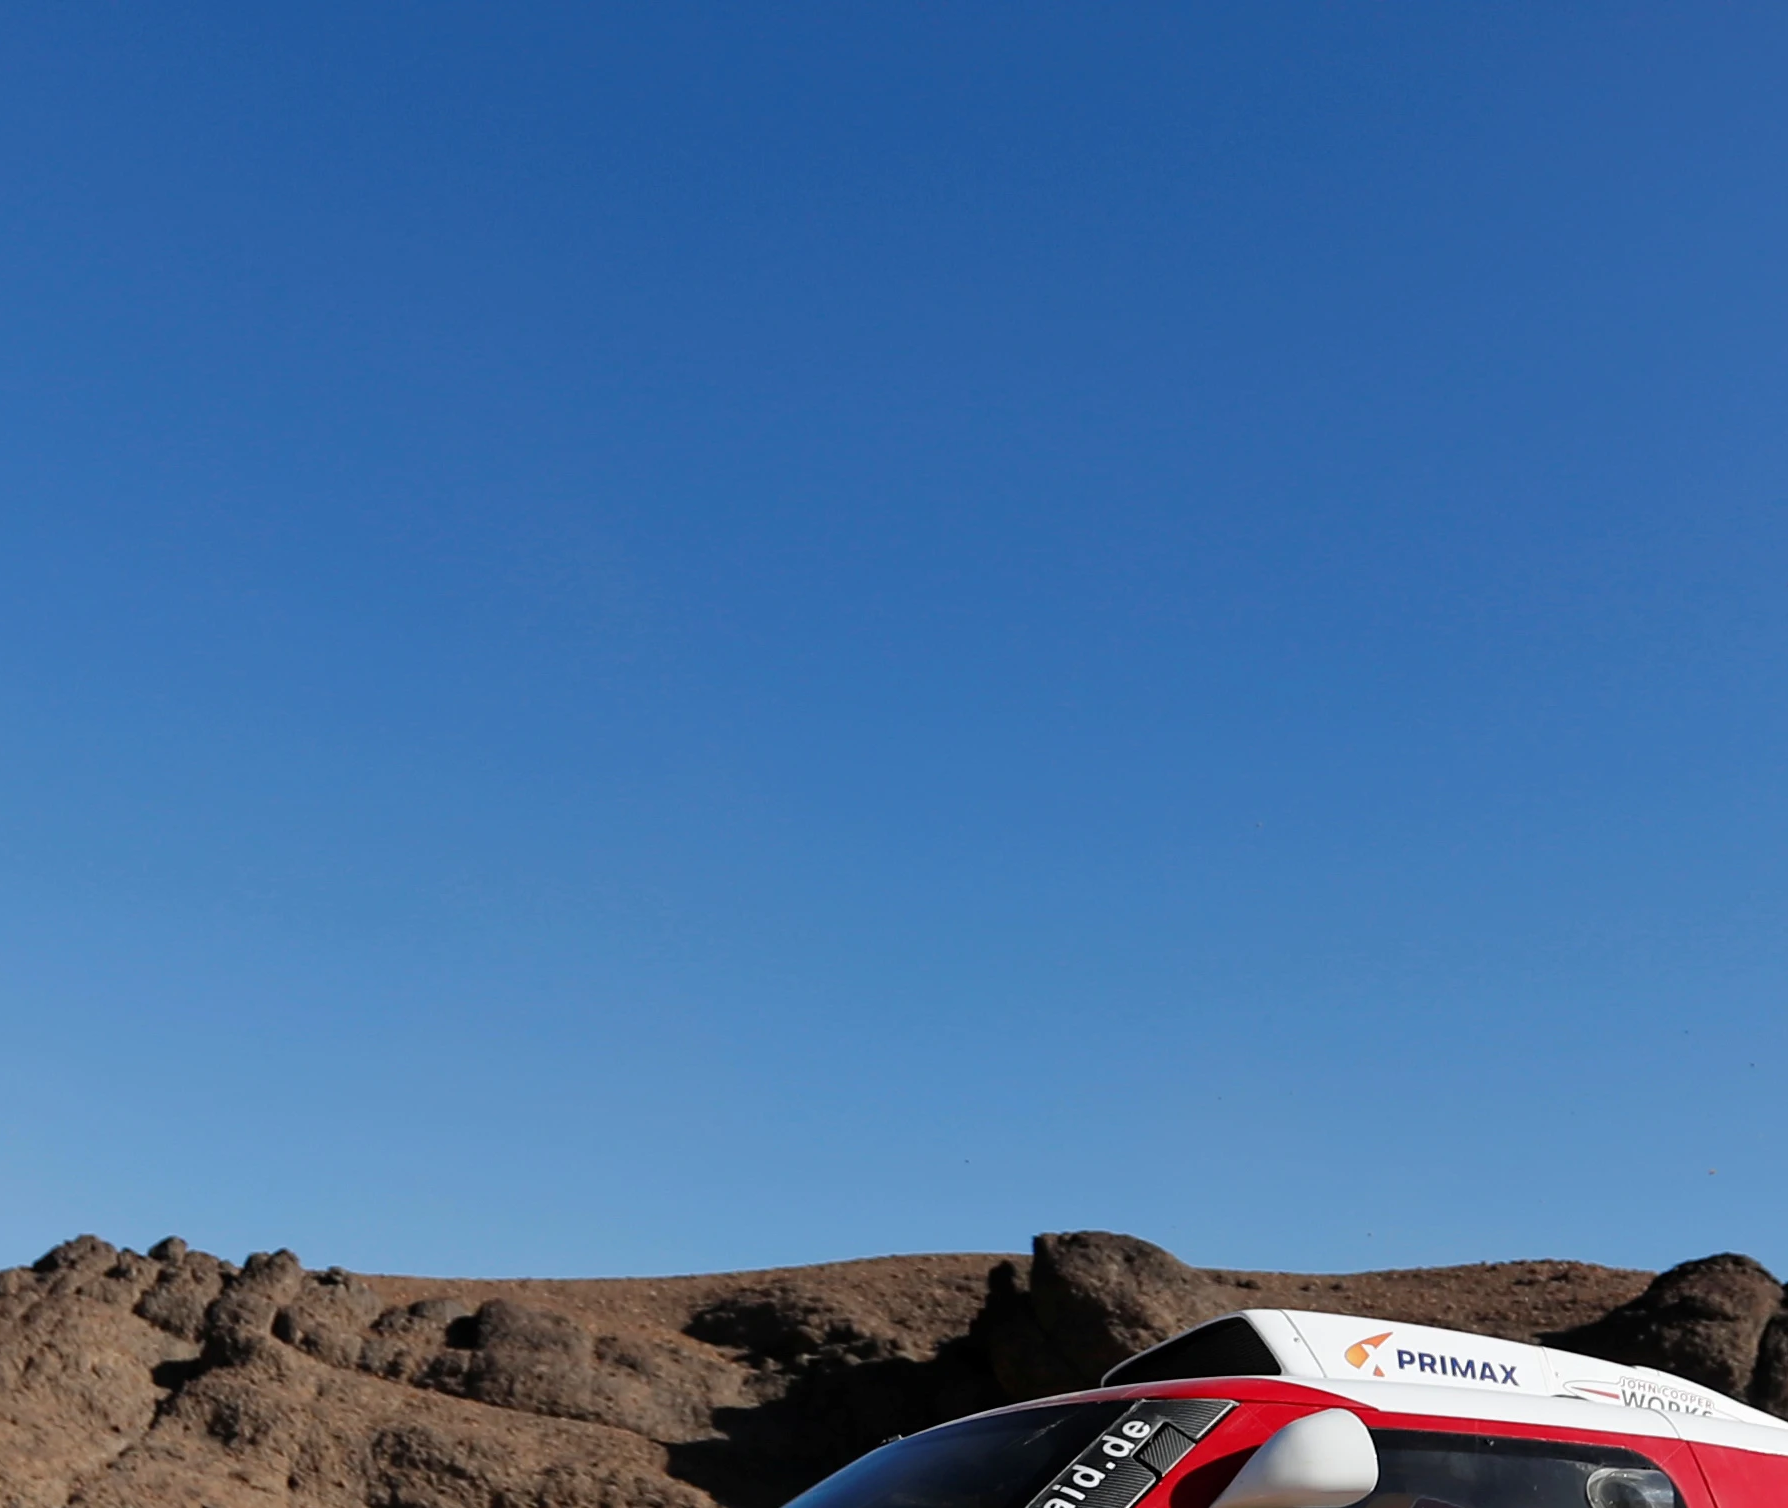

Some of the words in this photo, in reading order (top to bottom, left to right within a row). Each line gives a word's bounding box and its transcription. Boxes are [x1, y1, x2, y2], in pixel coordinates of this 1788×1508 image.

[1396, 1348, 1520, 1387] PRIMAX
[1620, 1378, 1657, 1395] JOHN
[1661, 1386, 1714, 1410] COOPER
